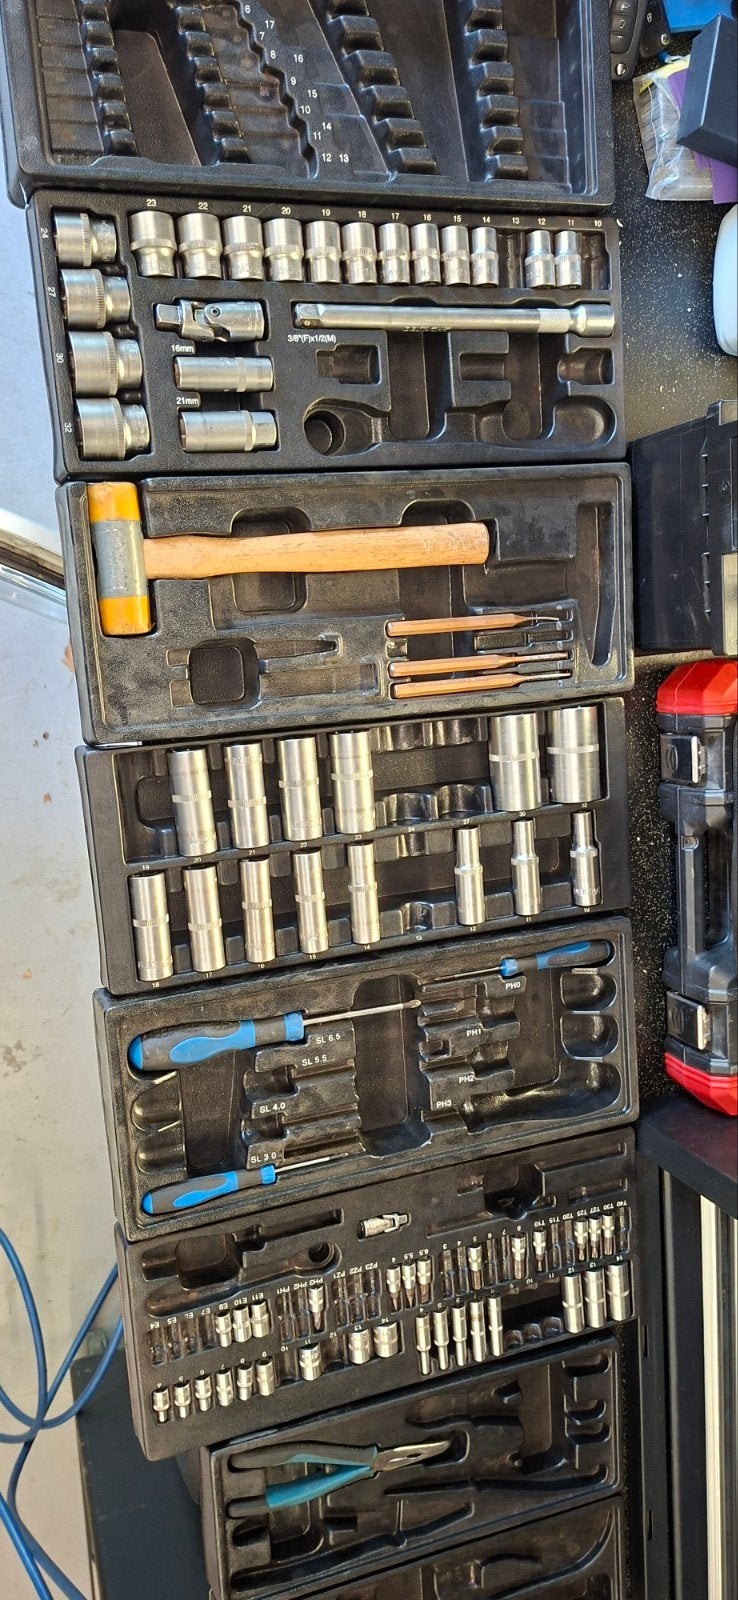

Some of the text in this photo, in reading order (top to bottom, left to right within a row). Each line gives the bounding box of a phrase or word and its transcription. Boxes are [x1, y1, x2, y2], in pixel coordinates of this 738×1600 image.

[245, 5, 250, 13] 6
[265, 20, 274, 29] 17
[260, 32, 264, 40] 7
[271, 51, 276, 59] 8
[294, 54, 304, 62] 16
[291, 77, 296, 86] 9
[308, 90, 318, 98] 15
[301, 106, 310, 114] 10
[322, 122, 332, 130] 14
[313, 132, 322, 140] 11
[322, 154, 332, 162] 12
[339, 154, 349, 162] 13
[41, 228, 48, 238] 24
[48, 287, 56, 298] 27
[171, 345, 194, 354] 16mm
[56, 353, 64, 363] 30
[65, 423, 72, 433] 32
[506, 982, 521, 990] PH0
[466, 1029, 482, 1037] PH1
[316, 1033, 341, 1045] SL 6.5
[302, 1055, 327, 1066] SL 5.5
[459, 1075, 474, 1084] PH2
[260, 1102, 286, 1114] SL 4.0
[436, 1100, 452, 1109] PH3
[250, 1152, 277, 1164] SL 3.0
[349, 1266, 362, 1274] PZ2
[333, 1271, 345, 1279] PZ1
[294, 1282, 307, 1290] PH2
[310, 1277, 324, 1286] PH3
[277, 1286, 290, 1294] PH1
[252, 1292, 264, 1301] E11
[234, 1297, 248, 1306] E10
[167, 1316, 177, 1325] E5
